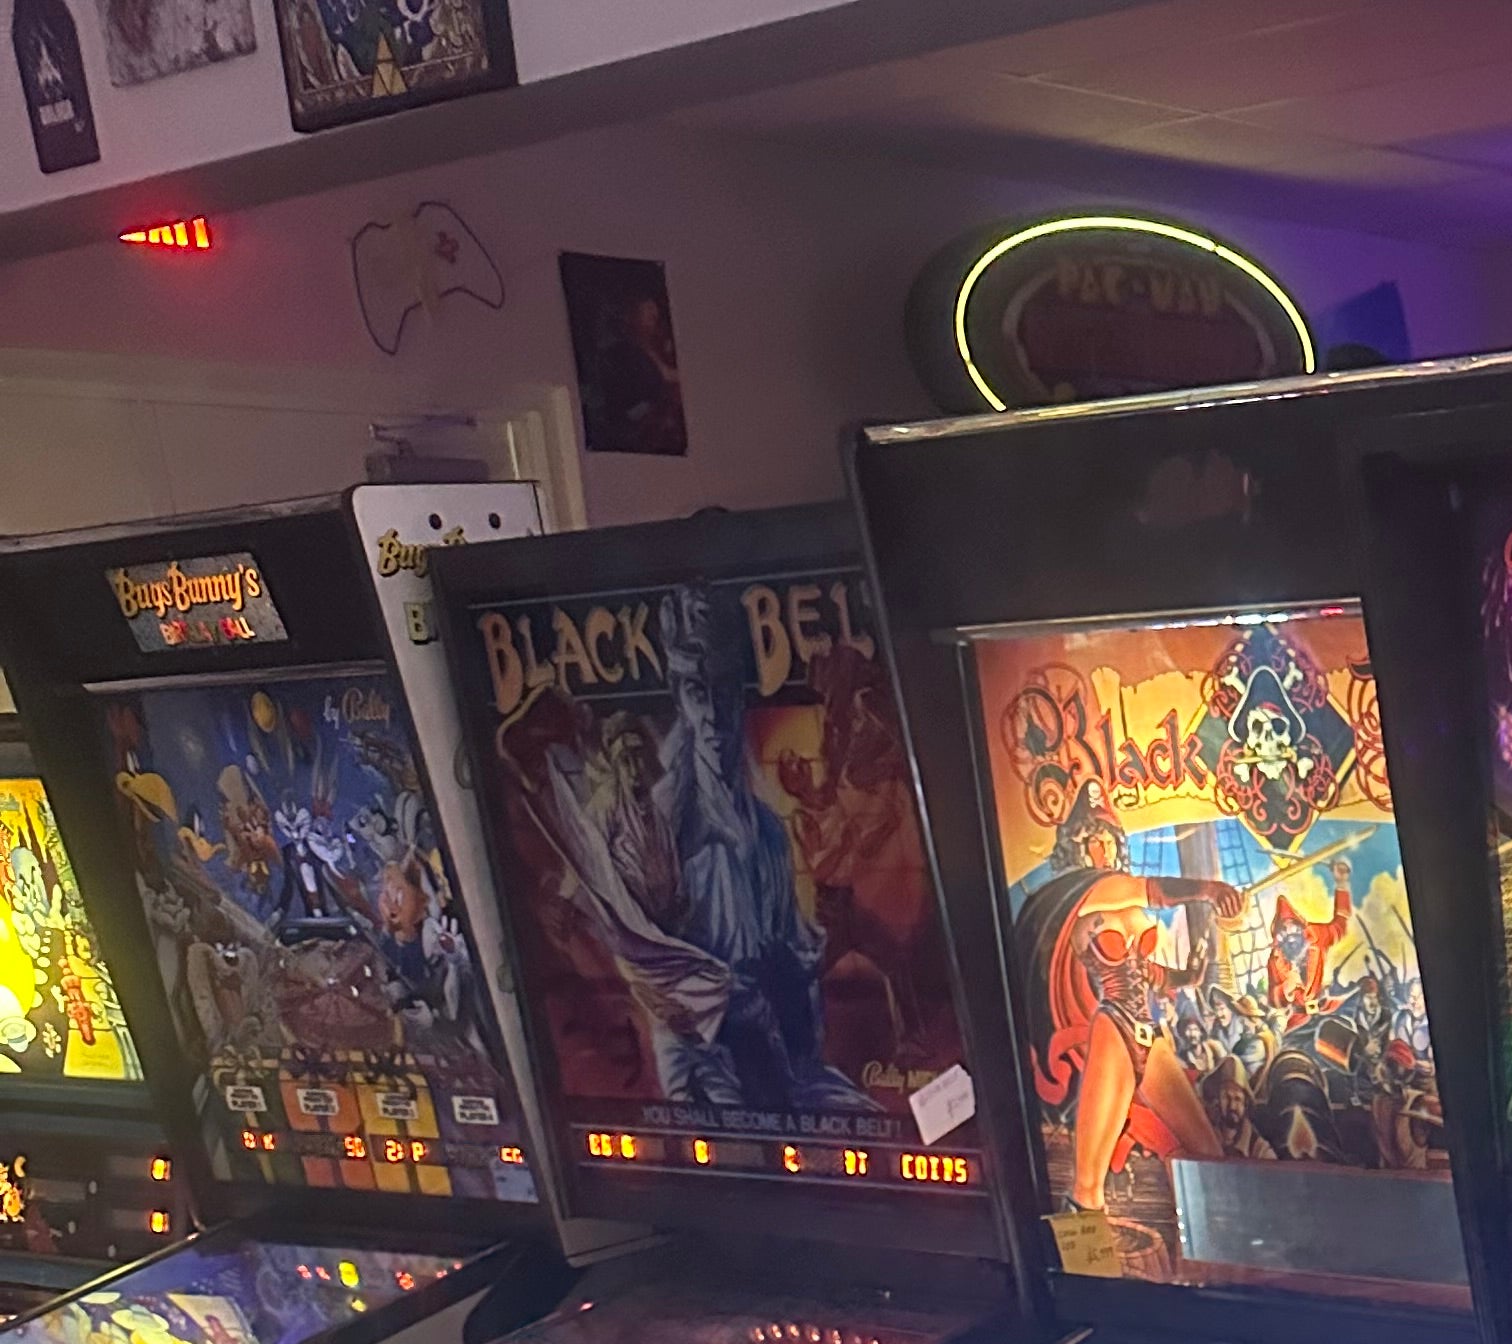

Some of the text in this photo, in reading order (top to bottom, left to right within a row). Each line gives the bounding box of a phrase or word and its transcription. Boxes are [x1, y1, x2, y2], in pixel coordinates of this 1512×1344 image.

[117, 561, 261, 618] Bugs Bunny's
[477, 580, 877, 715] BLACK BEL
[1003, 663, 1210, 829] Black
[642, 1106, 673, 1125] YOU
[674, 1108, 719, 1128] SHALL
[720, 1110, 785, 1133] BECOME
[784, 1115, 797, 1133] A
[800, 1115, 852, 1137] BLACK
